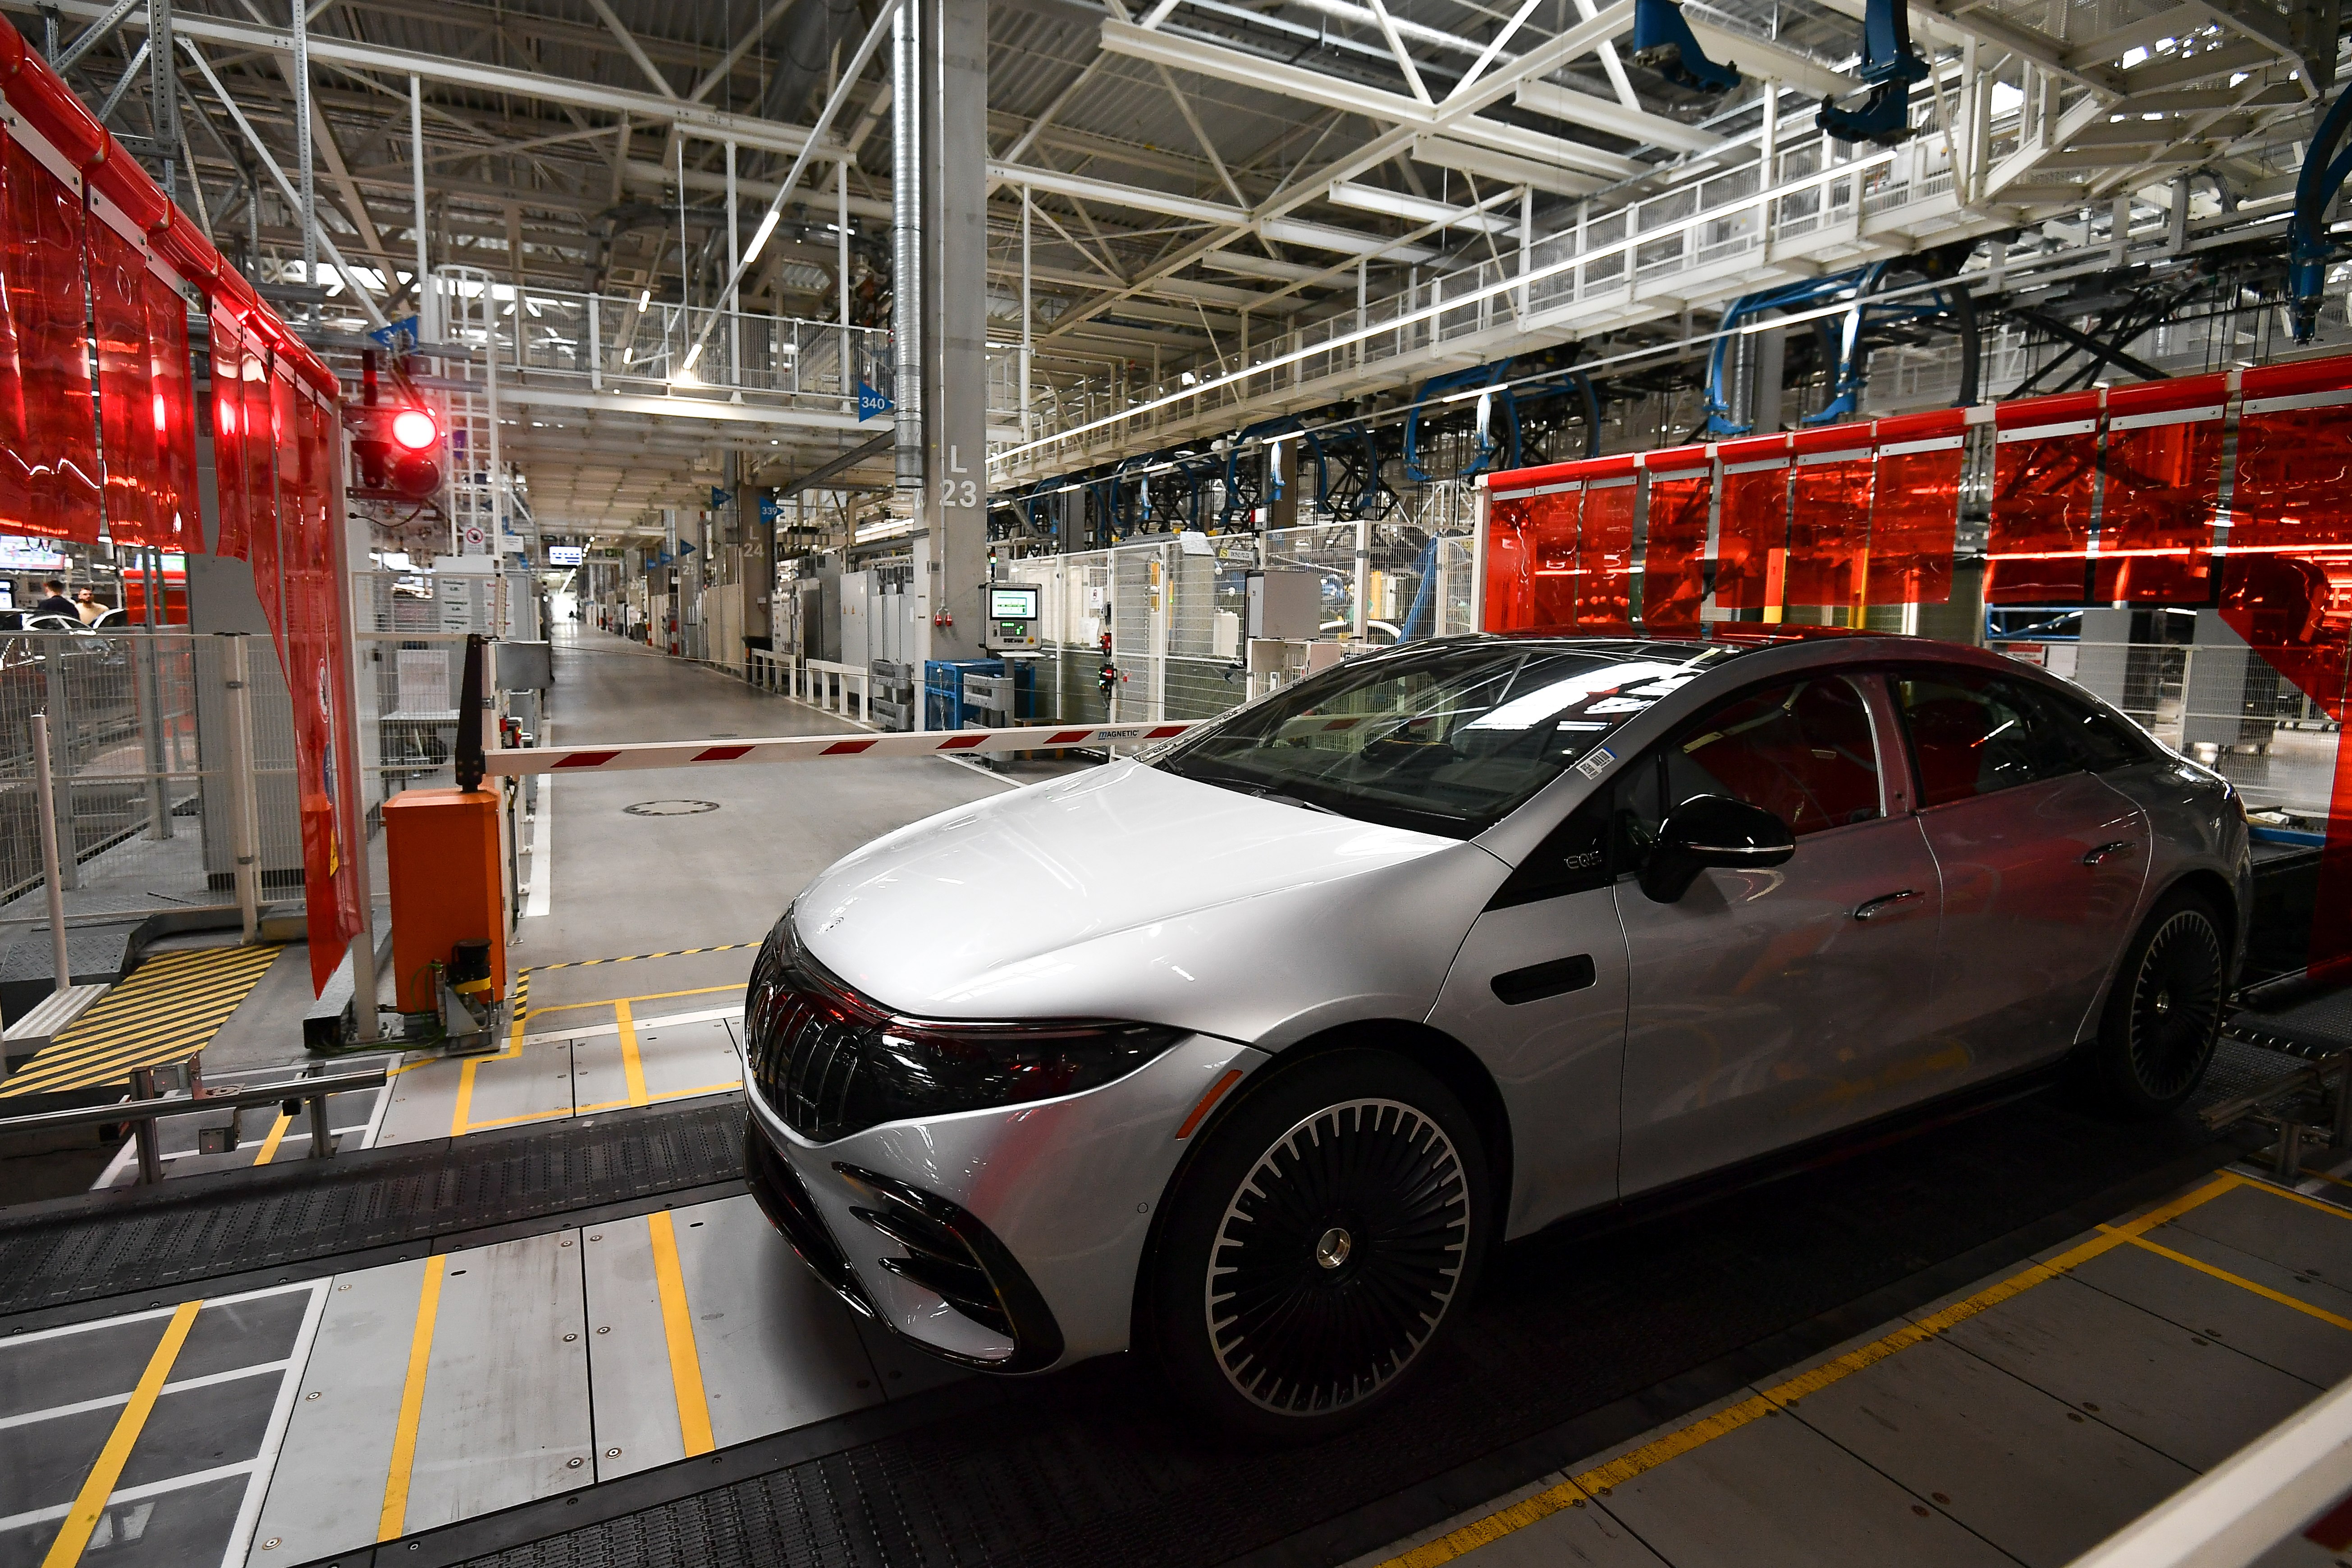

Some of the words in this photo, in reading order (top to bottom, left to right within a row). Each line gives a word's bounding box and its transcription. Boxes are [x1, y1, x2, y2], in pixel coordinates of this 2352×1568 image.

[862, 397, 885, 409] 340
[951, 445, 968, 473] L
[939, 479, 976, 507] 23
[762, 507, 778, 515] 339
[750, 526, 759, 540] L
[744, 543, 764, 557] 24
